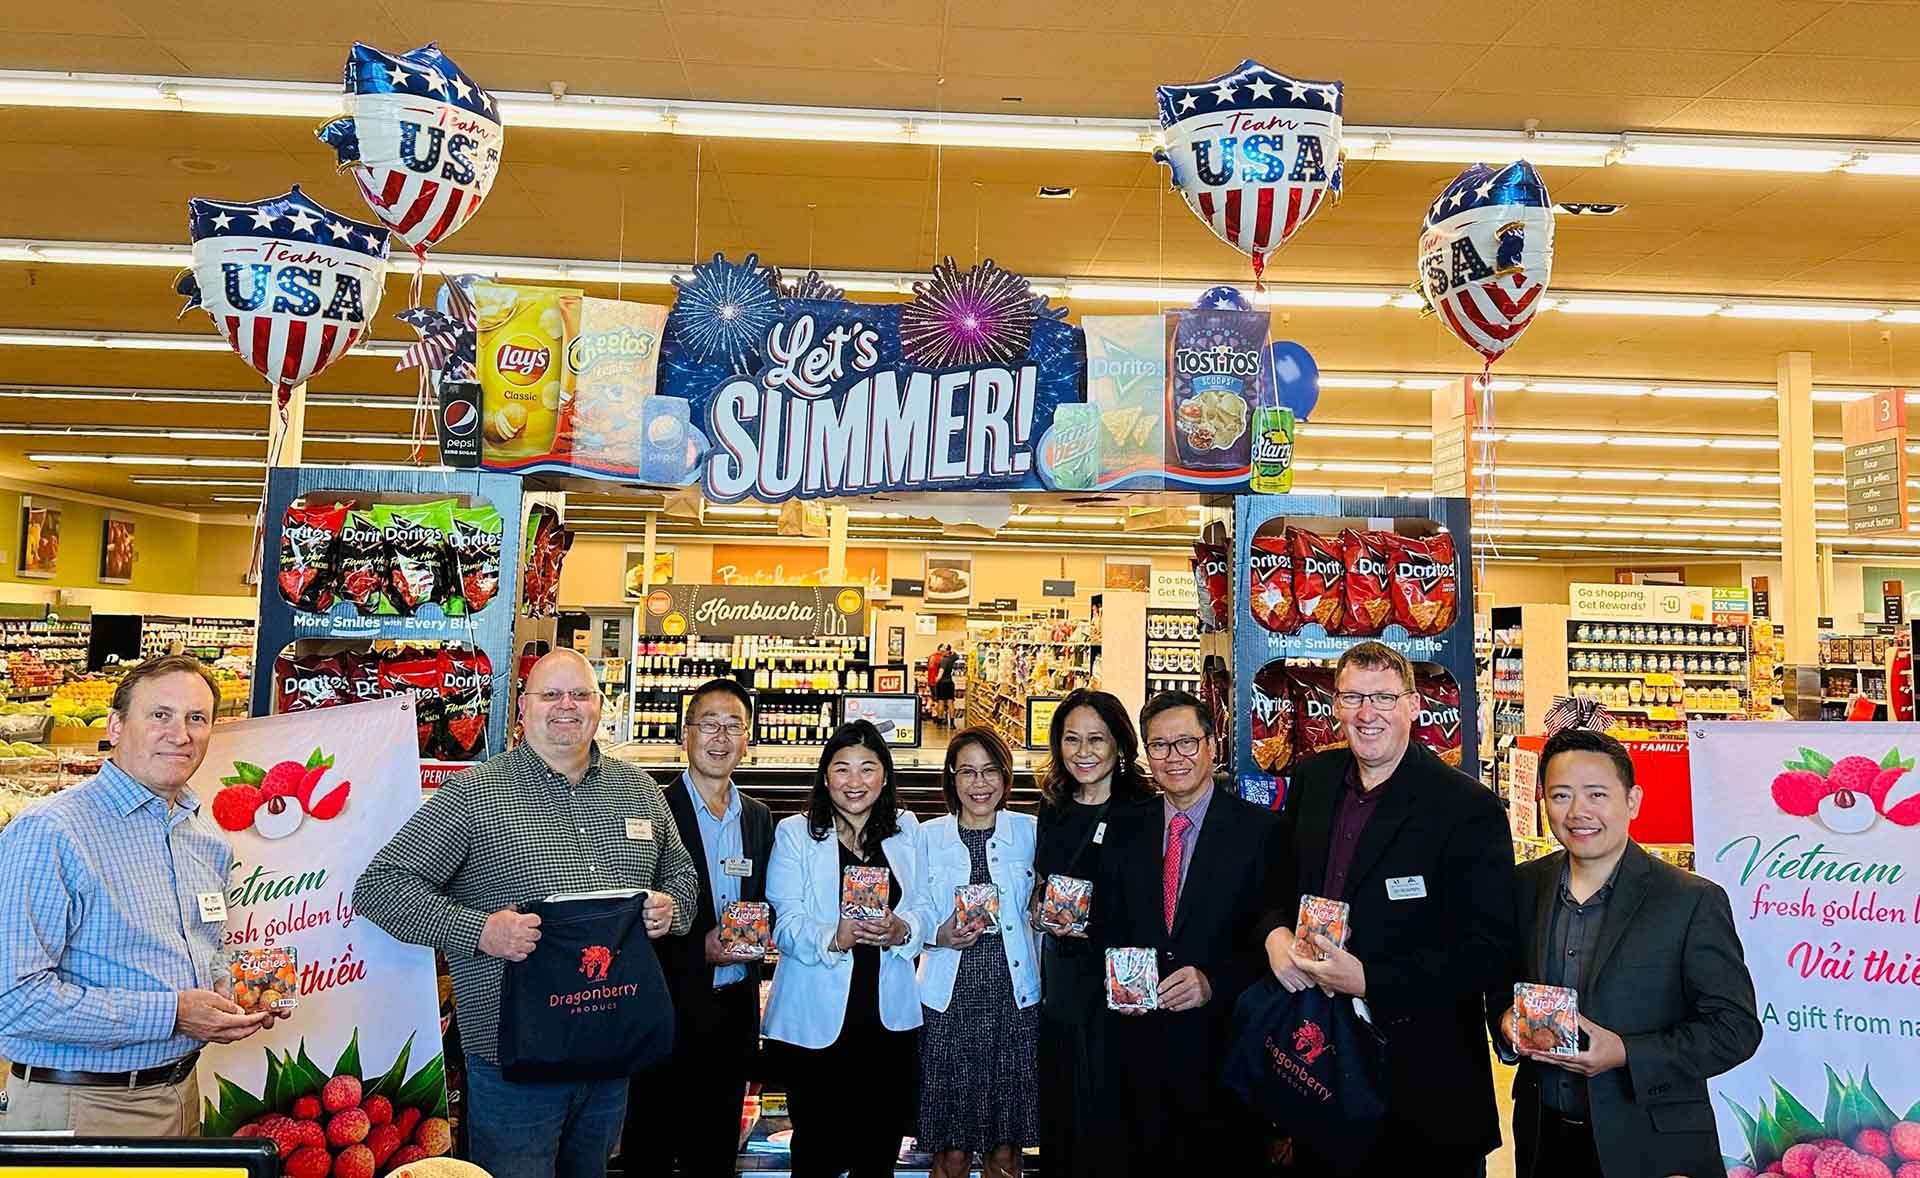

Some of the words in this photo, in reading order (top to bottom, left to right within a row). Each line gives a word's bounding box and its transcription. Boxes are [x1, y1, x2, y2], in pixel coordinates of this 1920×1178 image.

[1226, 112, 1298, 134] Team
[1192, 134, 1328, 186] USA
[262, 240, 339, 268] Team
[221, 262, 364, 322] USA
[500, 345, 548, 375] Lay's
[763, 316, 880, 400] Let's
[1201, 375, 1235, 386] SCOOPS!
[504, 390, 537, 401] Classic
[1880, 400, 1890, 421] 3
[707, 366, 1038, 498] SUMMER!
[446, 438, 475, 449] pepsi
[1252, 436, 1293, 467] Starry
[1863, 460, 1878, 469] flour
[1862, 489, 1881, 499] coffee
[1867, 505, 1878, 513] tea
[1854, 520, 1875, 530] peanut
[1876, 517, 1895, 527] butter
[385, 527, 442, 541] Doritos
[1398, 562, 1455, 578] Doritos
[1158, 576, 1172, 585] Go
[1158, 588, 1176, 597] Get
[1578, 588, 1593, 597] Go
[1714, 588, 1729, 598] 2X
[696, 598, 816, 627] Kombucha
[1578, 601, 1597, 609] Get
[293, 615, 330, 628] More
[333, 615, 381, 629] Smiles
[383, 617, 402, 626] with
[405, 617, 446, 631] Every
[1714, 614, 1729, 624] 4X
[1268, 636, 1301, 650] More
[1304, 637, 1350, 651] Smiles
[1384, 638, 1411, 652] very
[881, 678, 900, 690] CLIF
[896, 728, 907, 739] 16
[1640, 743, 1684, 752] FAMILY
[1715, 834, 1908, 887] Vietnam
[228, 862, 329, 908] etnam
[1750, 883, 1817, 920] fresh
[1823, 890, 1906, 926] golden
[264, 900, 332, 947] golden
[728, 907, 762, 925] Lychee
[240, 953, 288, 975] Lychee
[1787, 941, 1855, 980] Vải
[300, 944, 367, 996] thiều
[549, 983, 638, 1007] Dragonberry
[1762, 1003, 1780, 1025] A
[1788, 1005, 1828, 1033] gift
[1834, 1008, 1891, 1035] from
[1264, 1035, 1333, 1101] Dragonberry
